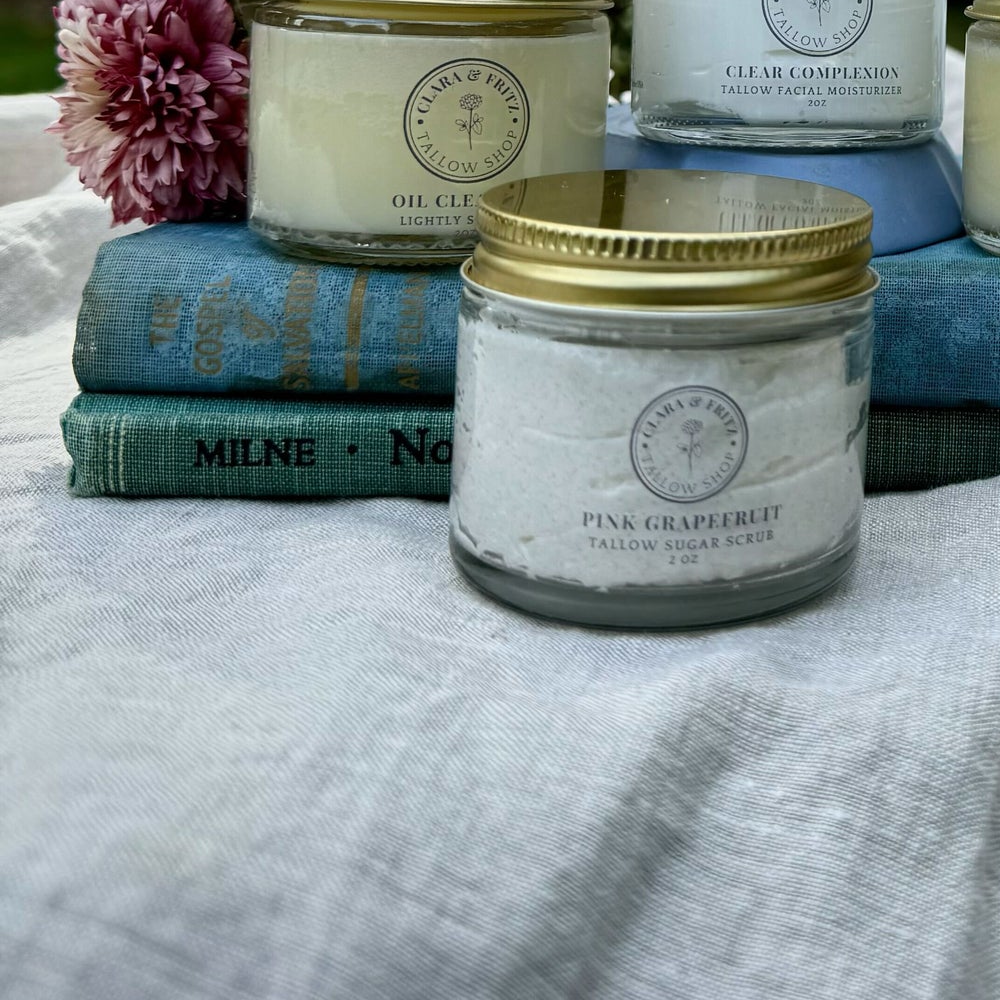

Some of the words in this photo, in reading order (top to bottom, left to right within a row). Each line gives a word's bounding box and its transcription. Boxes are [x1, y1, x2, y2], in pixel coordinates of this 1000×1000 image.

[773, 9, 828, 48] TALLOW
[832, 10, 862, 44] SHOP
[726, 65, 783, 79] CLEAR
[789, 66, 900, 80] COMPLEXION
[417, 72, 463, 114] CLARA
[467, 69, 481, 81] &
[485, 73, 520, 114] FRITZ
[721, 85, 773, 95] TALLOW
[778, 86, 823, 95] FACIAL
[827, 86, 902, 95] MOISTURIZER
[417, 131, 478, 173] TALLOW
[484, 130, 517, 168] SHOP
[392, 194, 427, 208] OIL
[400, 215, 461, 226] LIGHTLY
[150, 293, 183, 347] THE
[193, 274, 232, 376] GOSPEL
[643, 399, 685, 439] CLARA
[690, 396, 702, 407] &
[705, 399, 739, 437] FRITZ
[193, 438, 316, 467] MILNE
[641, 456, 698, 495] TALLOW
[703, 452, 735, 489] SHOP
[582, 511, 636, 531] PINK
[645, 504, 783, 531] GRAPEFRUIT
[588, 536, 658, 551] TALLOW
[665, 537, 720, 550] SUGAR
[726, 530, 775, 547] SCRUB
